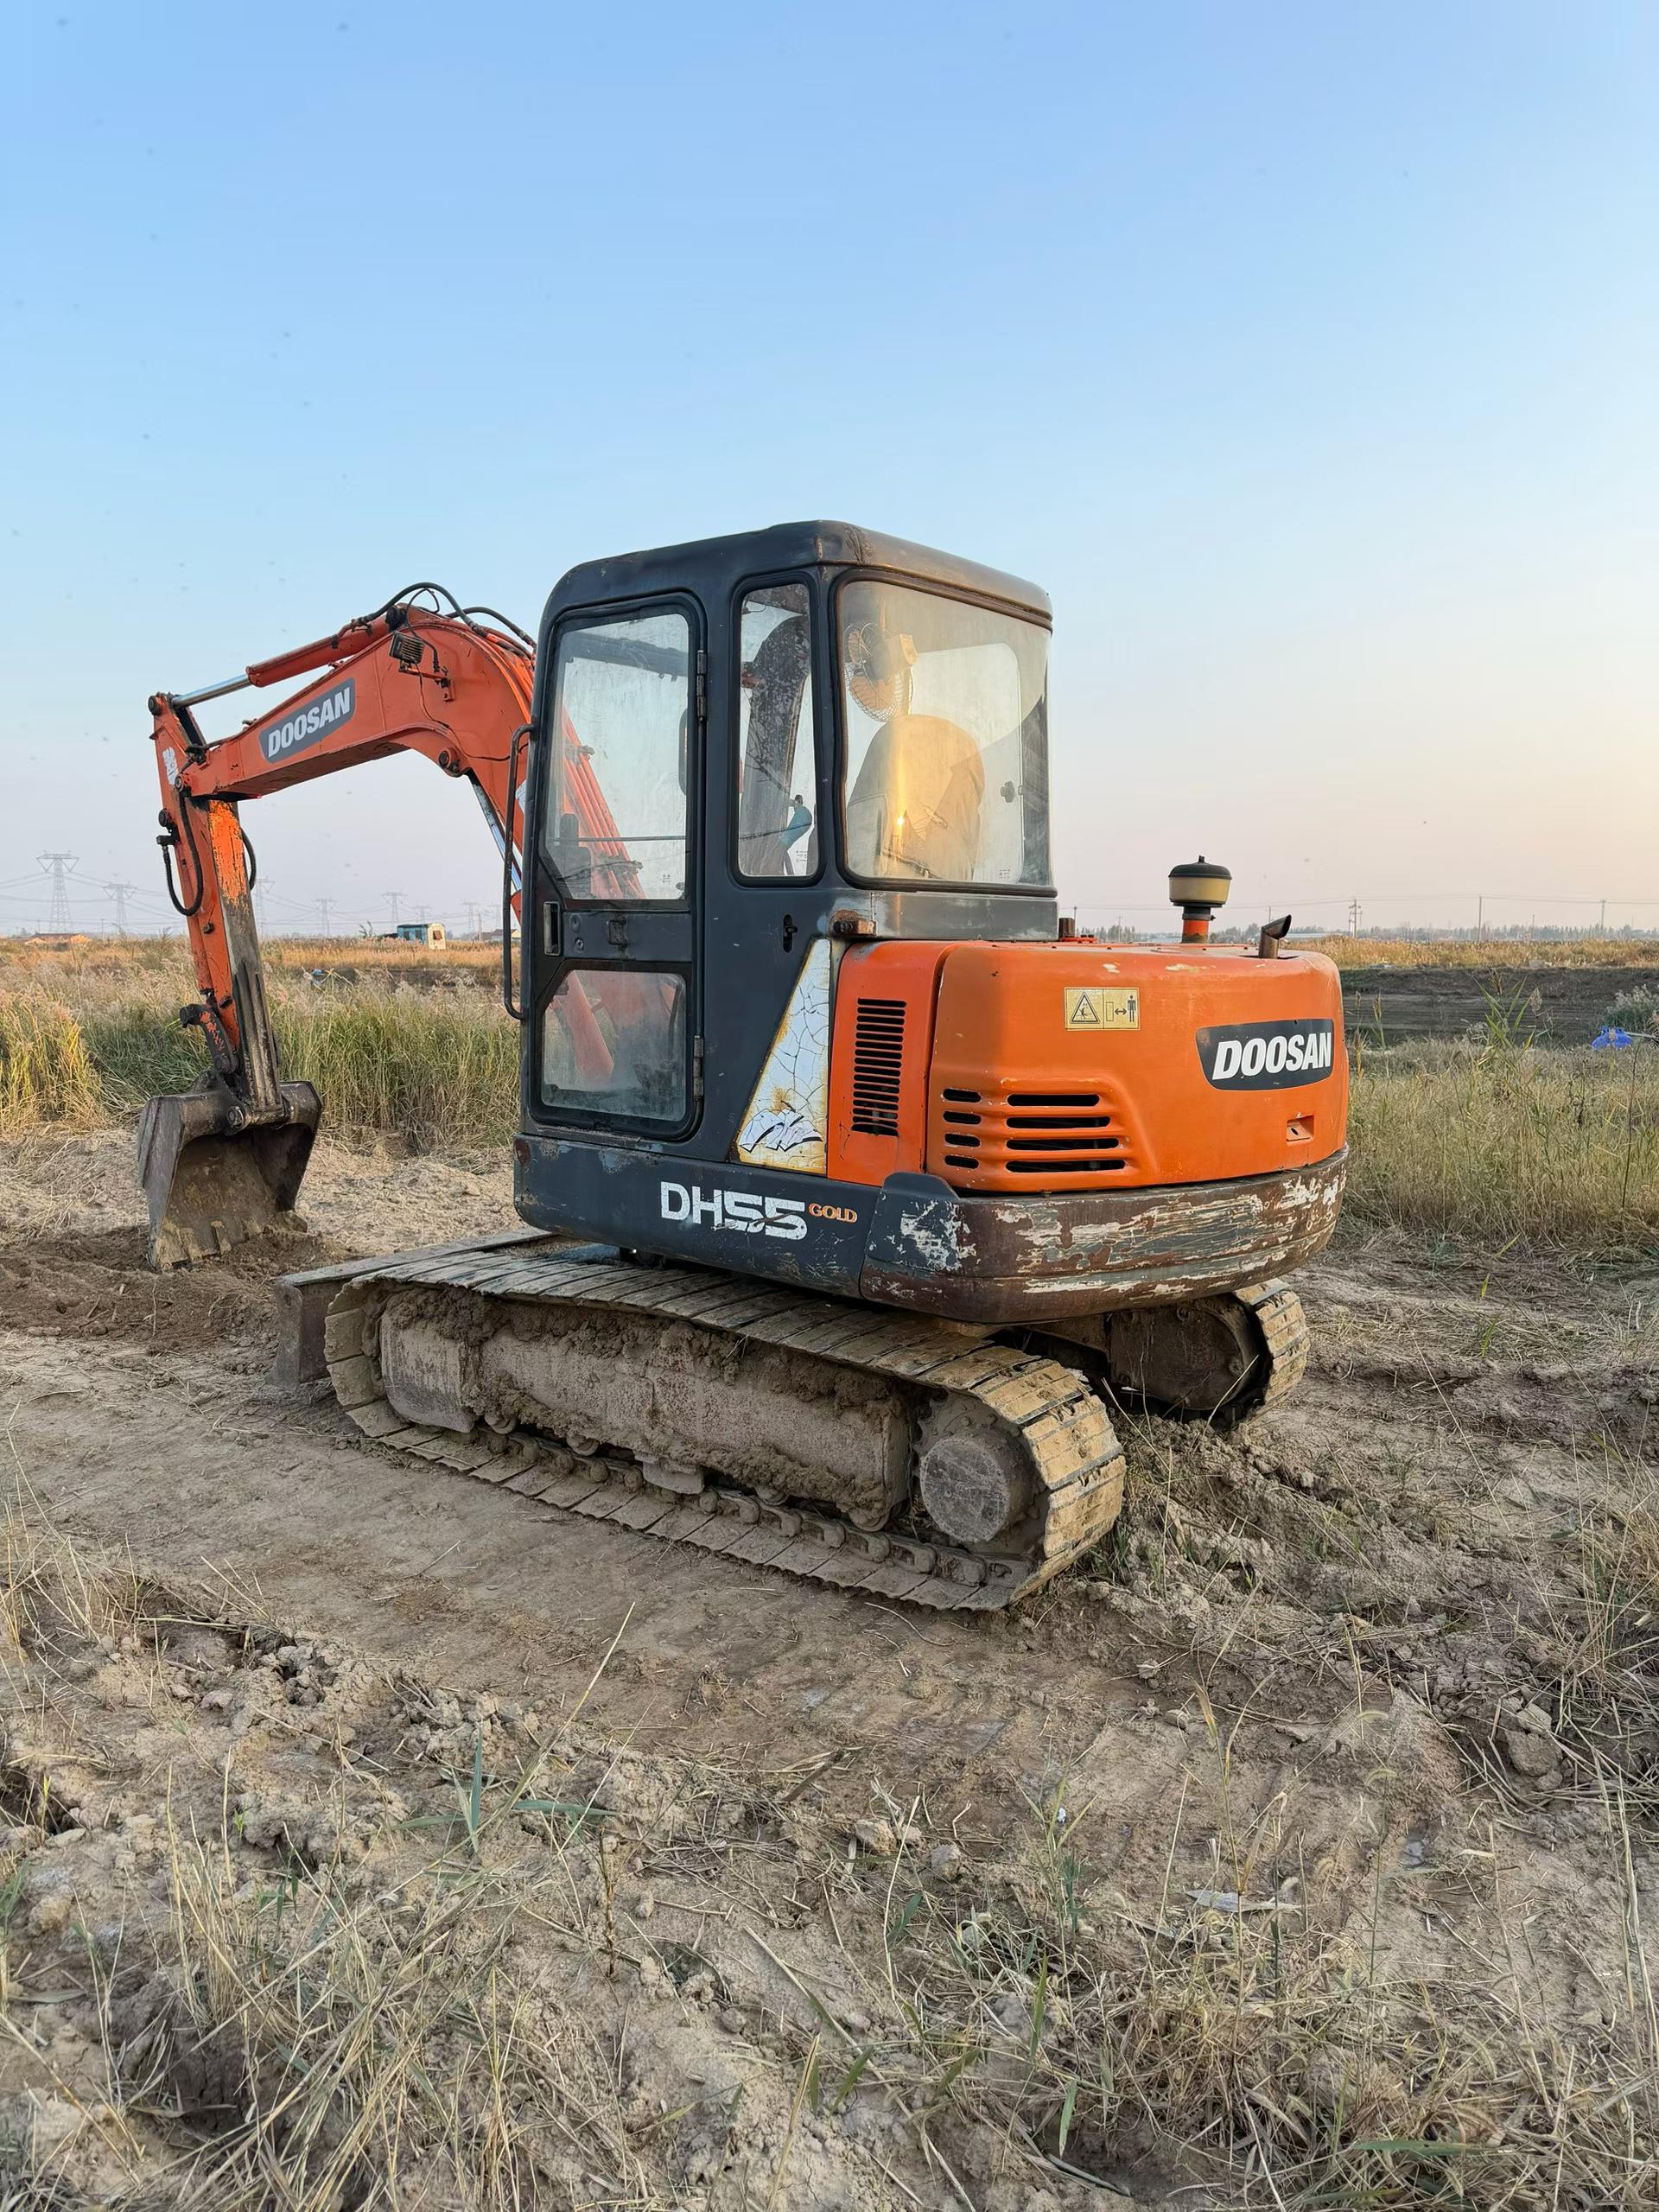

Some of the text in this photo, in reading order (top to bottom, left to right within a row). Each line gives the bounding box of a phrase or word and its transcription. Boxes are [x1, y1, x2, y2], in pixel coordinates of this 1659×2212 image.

[268, 687, 350, 758] DOOSAN
[1211, 1033, 1332, 1081] DOOSAN
[660, 1181, 858, 1241] DH55 GOLD
